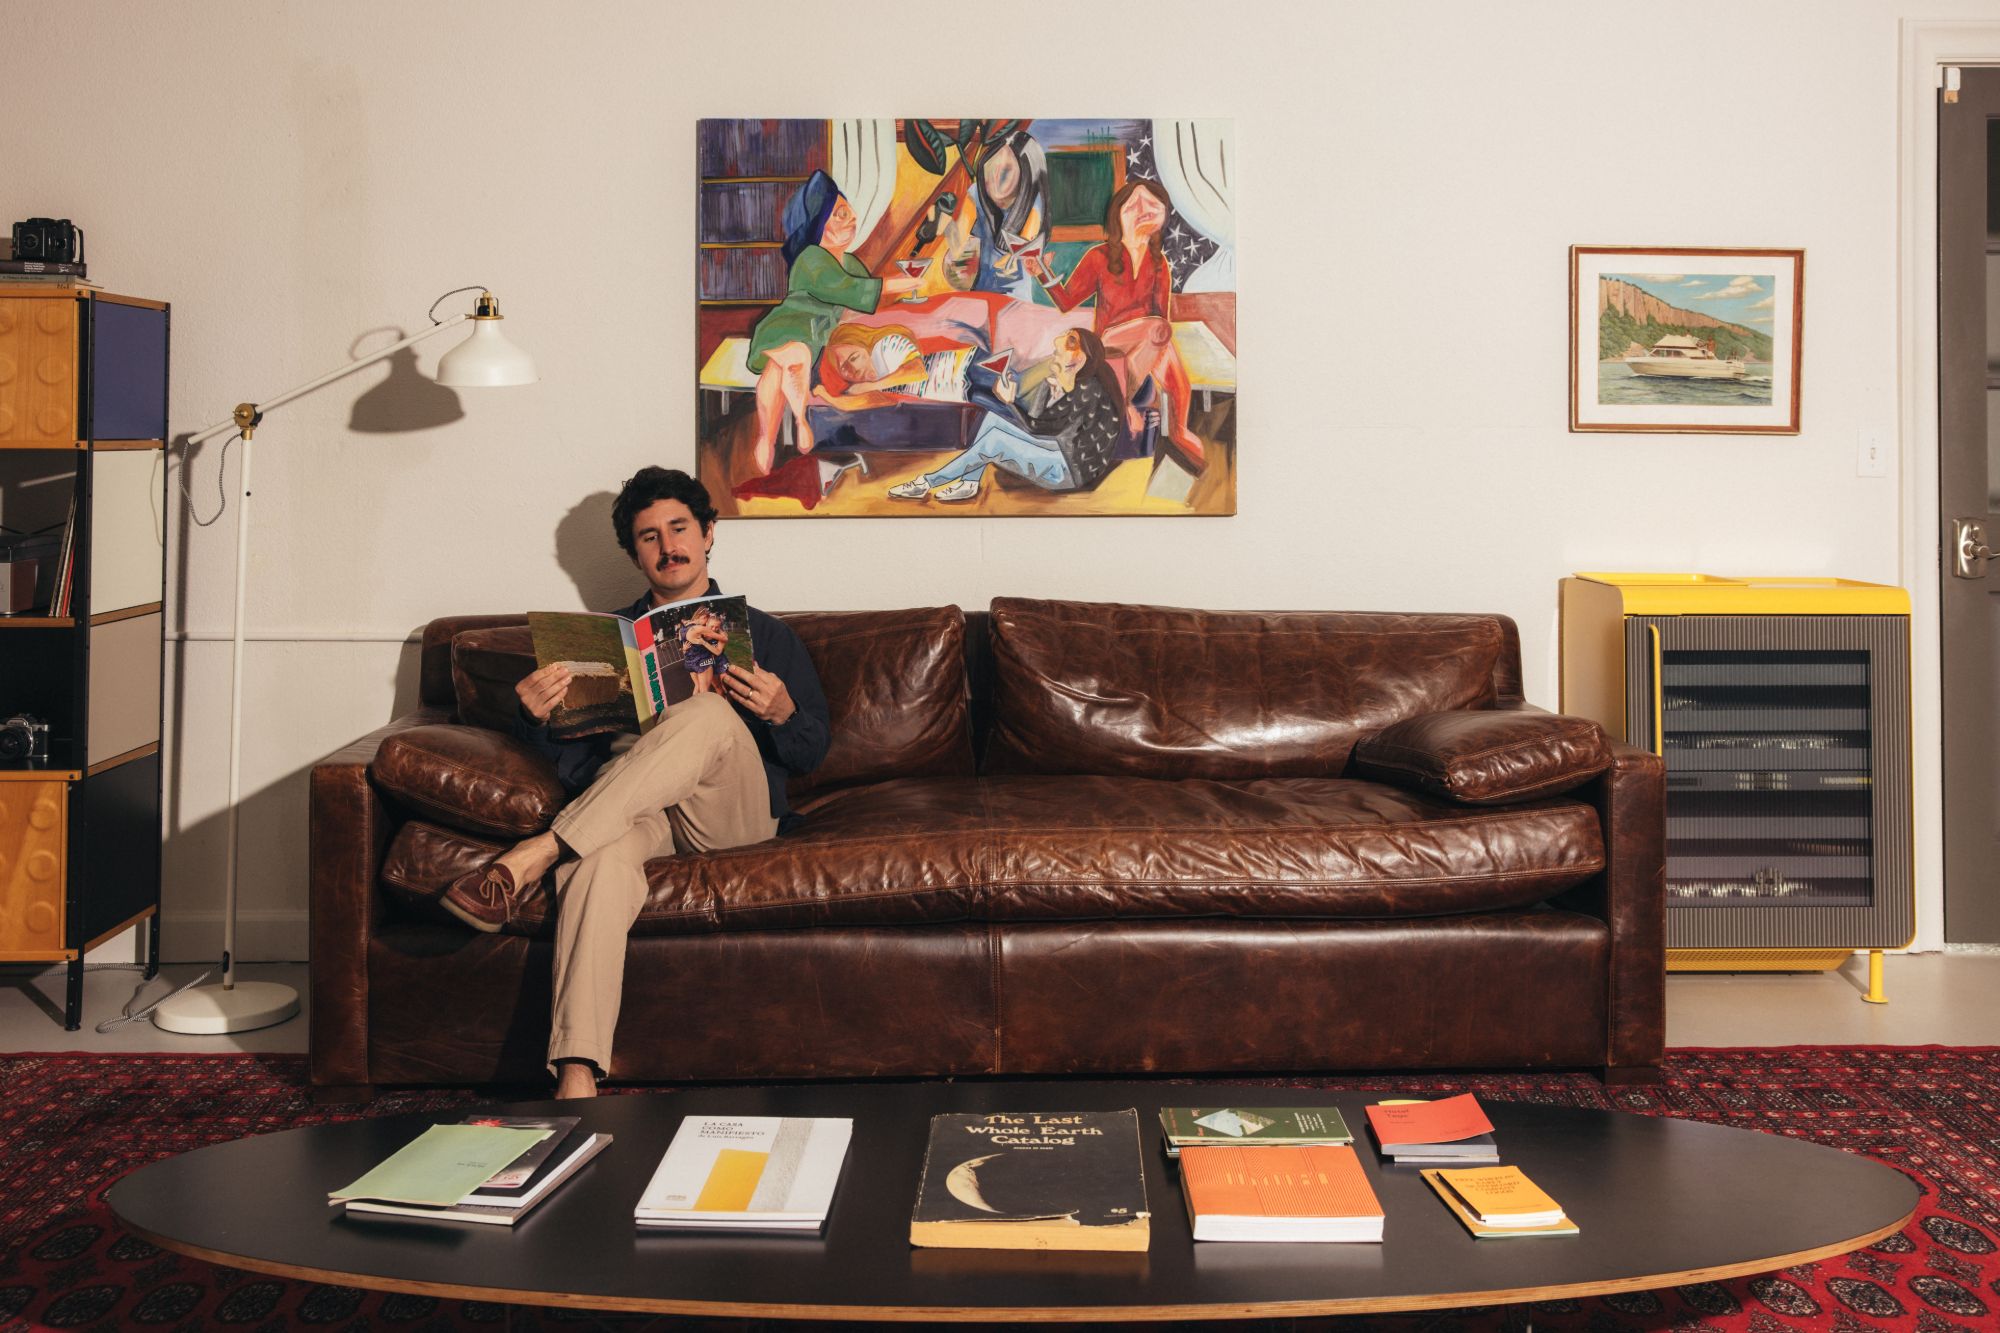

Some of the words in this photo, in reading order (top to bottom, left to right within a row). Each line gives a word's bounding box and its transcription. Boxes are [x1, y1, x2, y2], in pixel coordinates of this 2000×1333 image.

[984, 1114, 1025, 1125] The
[1033, 1115, 1083, 1125] Last
[965, 1125, 1031, 1135] Whole
[1040, 1125, 1104, 1136] Earth
[990, 1135, 1076, 1146] Catalog
